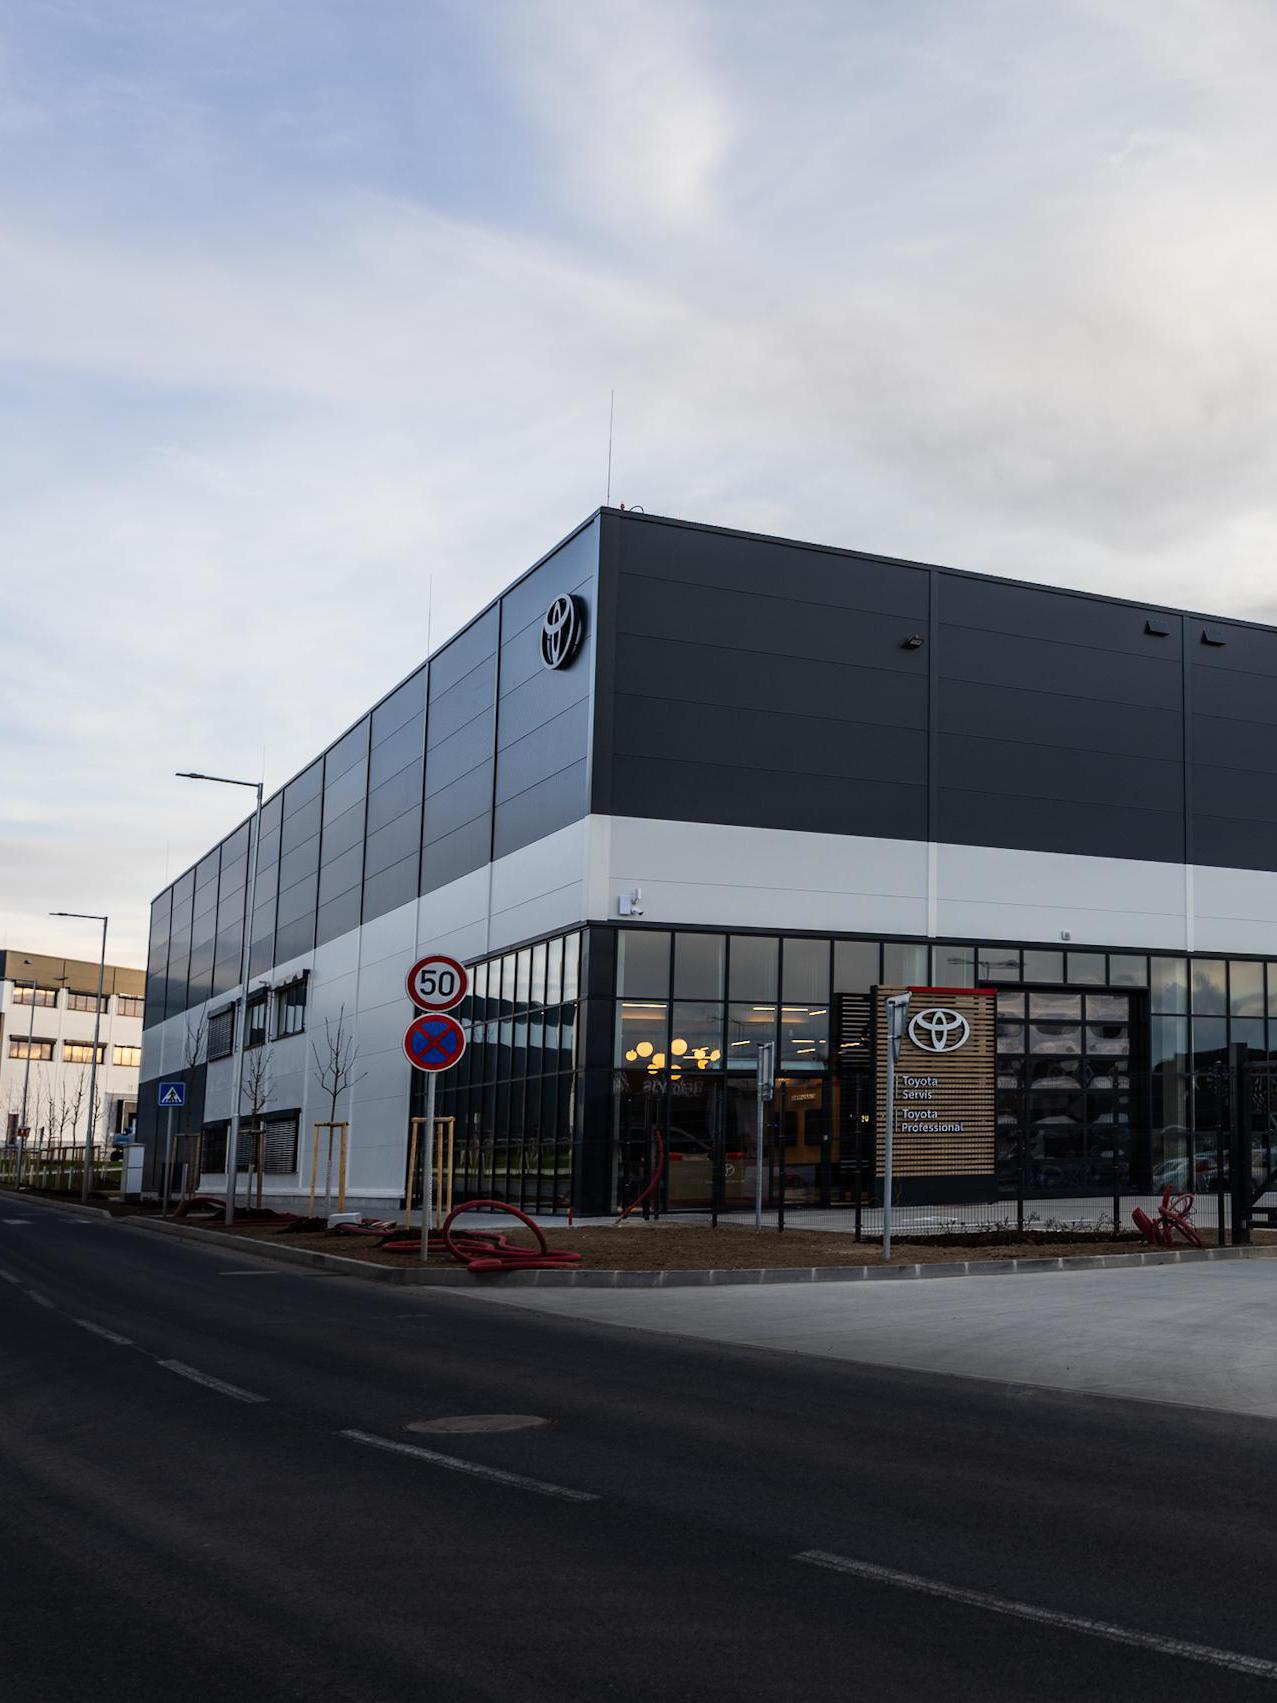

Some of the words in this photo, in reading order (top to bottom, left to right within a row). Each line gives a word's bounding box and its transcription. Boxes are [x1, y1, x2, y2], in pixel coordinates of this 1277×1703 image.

[419, 969, 455, 997] 50
[902, 1075, 938, 1088] Toyota
[902, 1089, 933, 1100] Servis
[902, 1108, 938, 1121] Toyota
[901, 1122, 965, 1132] Professional
